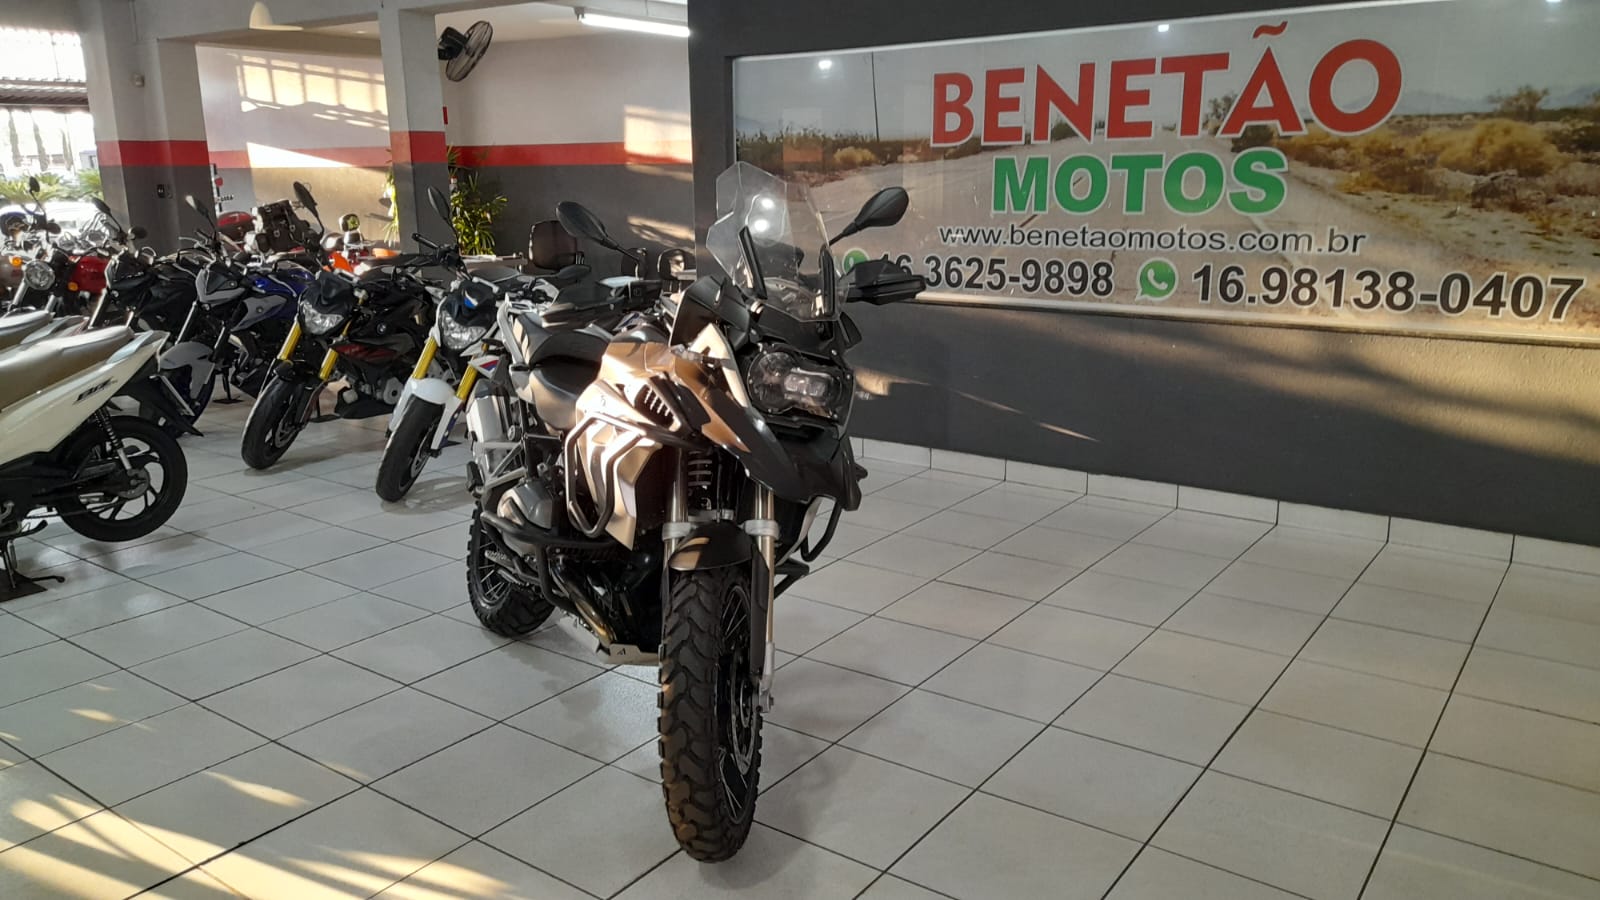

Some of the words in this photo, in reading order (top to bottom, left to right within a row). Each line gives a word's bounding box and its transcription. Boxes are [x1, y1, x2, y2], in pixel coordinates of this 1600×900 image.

[931, 21, 1401, 144] BENETÃO
[993, 150, 1286, 214] MOTOS
[940, 223, 1366, 254] www.benetaomotos.com.br
[1193, 264, 1585, 320] 16.98138-0407
